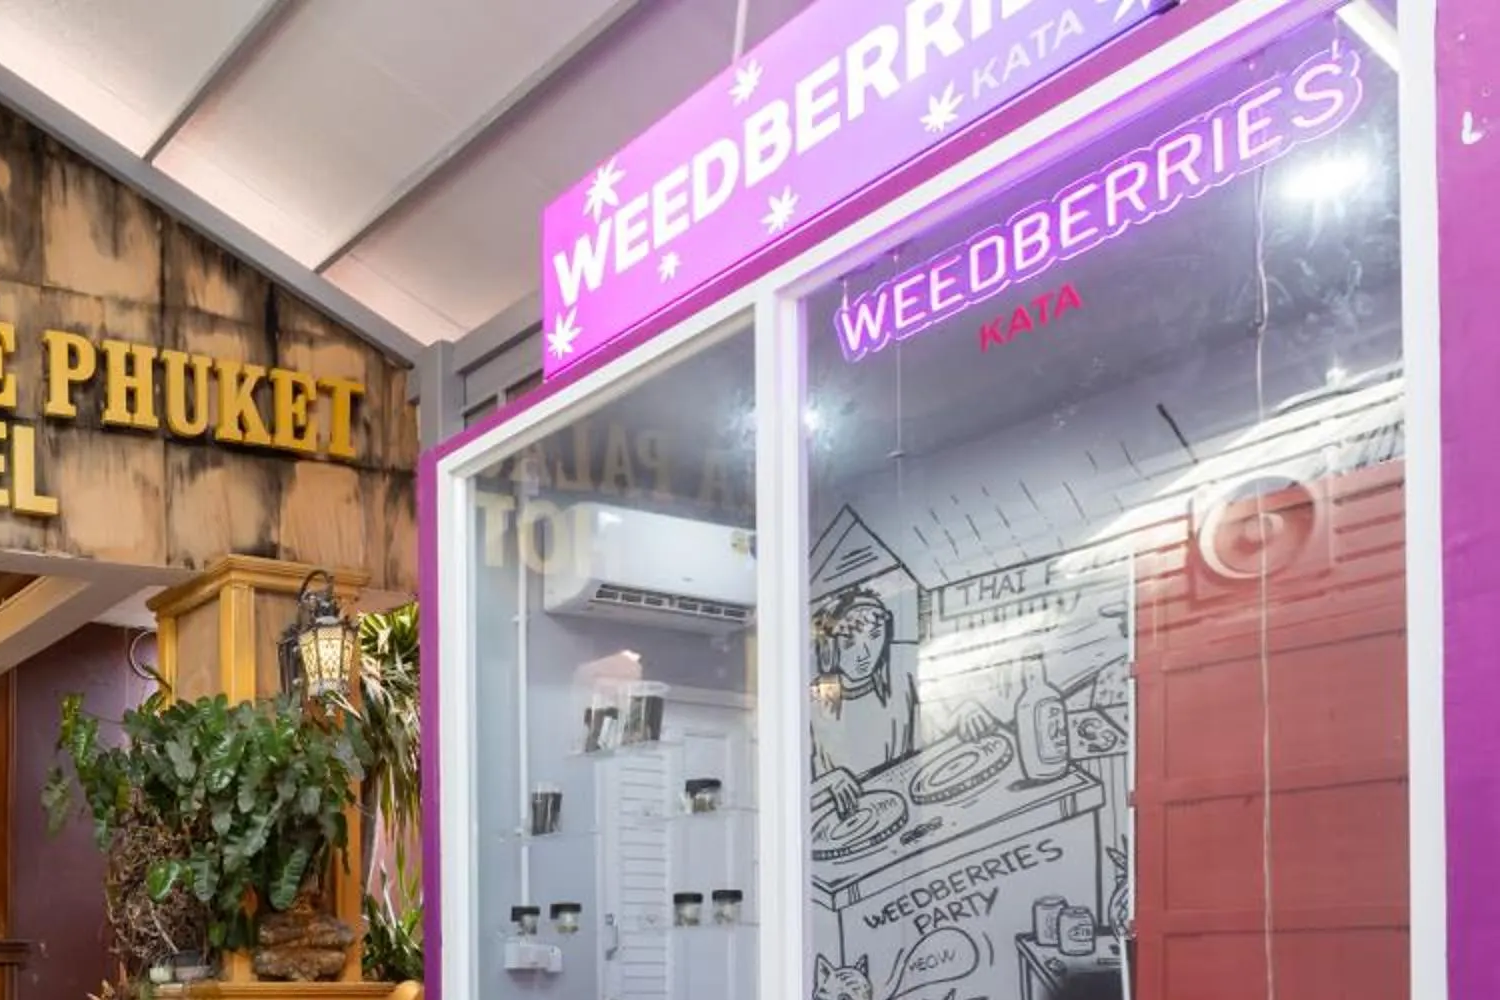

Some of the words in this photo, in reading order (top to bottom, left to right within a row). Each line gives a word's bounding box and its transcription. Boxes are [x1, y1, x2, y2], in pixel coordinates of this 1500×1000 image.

[970, 8, 1086, 100] KATA
[553, 0, 1104, 305] WEEDBERR
[840, 62, 1346, 352] WEEDBERRIES
[979, 280, 1082, 353] KATA
[41, 328, 366, 460] PHUKET
[956, 568, 1027, 606] THAI
[863, 838, 1064, 929] WEEDBERRIES
[913, 887, 999, 936] PARTY
[909, 949, 957, 971] MEOW
